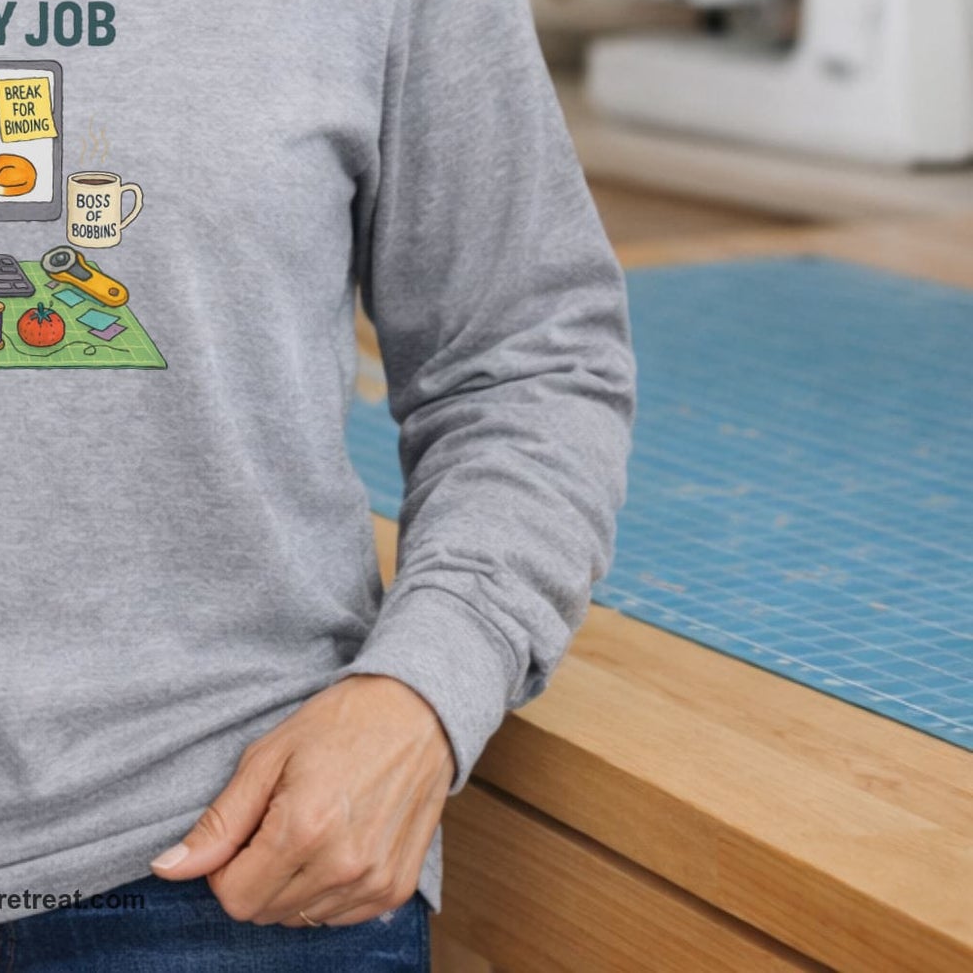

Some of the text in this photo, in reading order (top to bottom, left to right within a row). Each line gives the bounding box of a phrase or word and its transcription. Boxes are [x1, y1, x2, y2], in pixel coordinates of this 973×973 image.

[25, 1, 116, 47] JOB
[4, 84, 43, 100] BREAK
[12, 102, 36, 117] FOR
[4, 118, 50, 135] BINDING
[76, 194, 111, 209] BOSS
[85, 210, 103, 222] OF
[71, 223, 117, 239] BOBBINS
